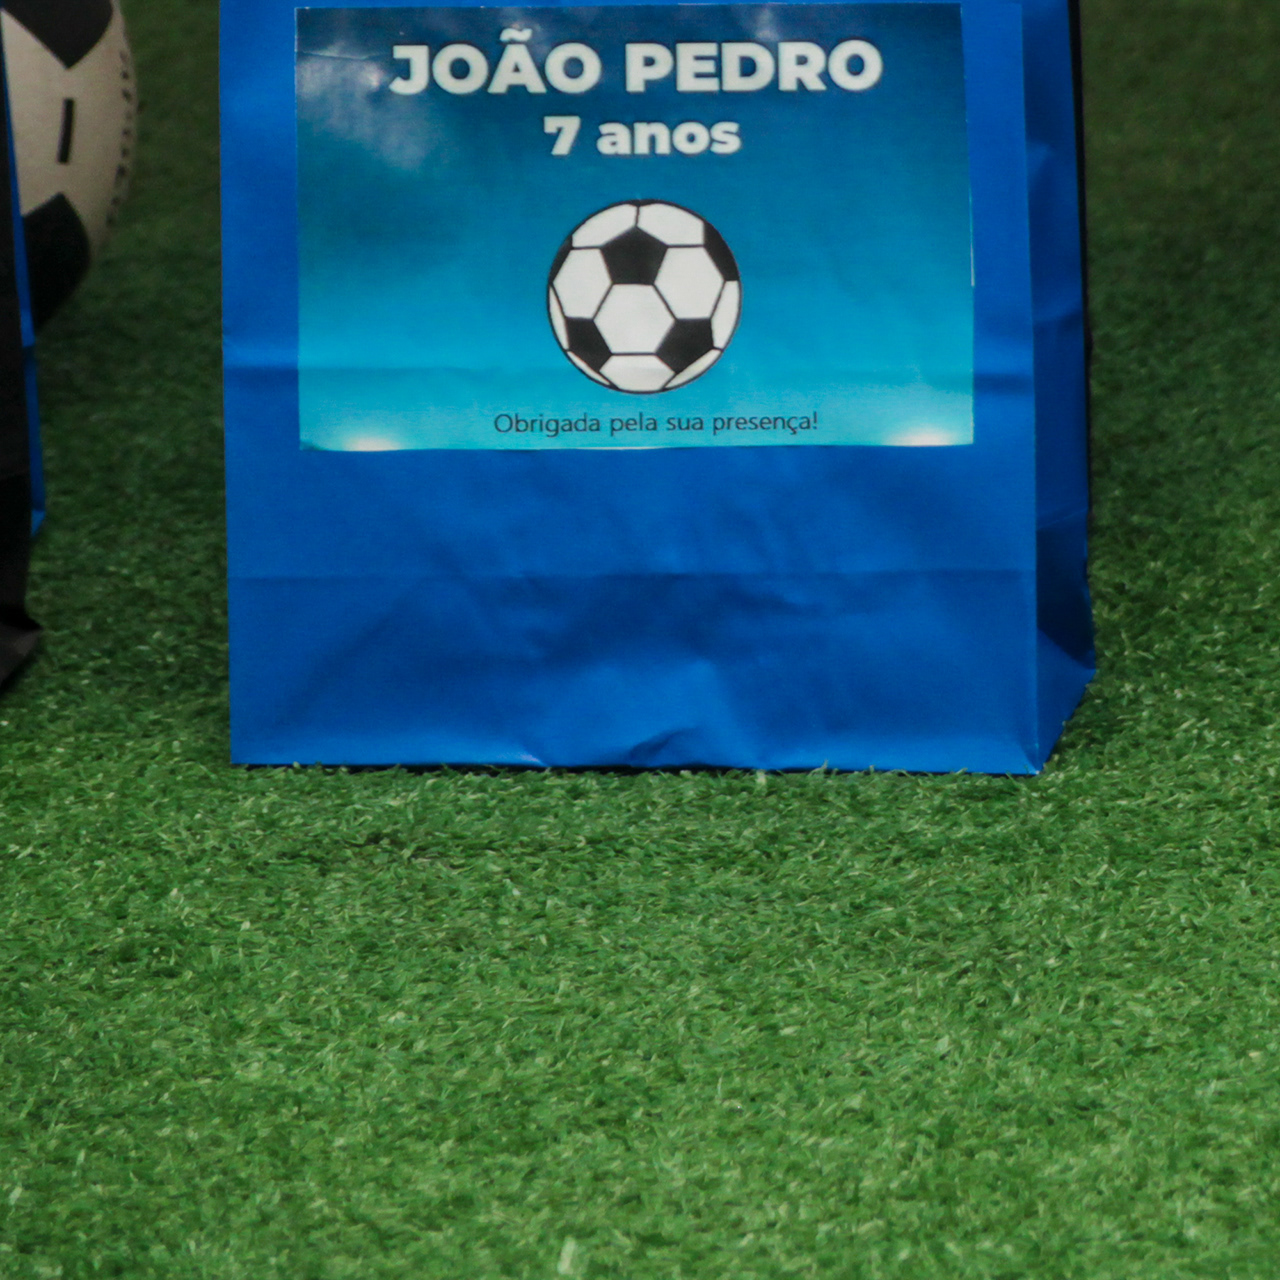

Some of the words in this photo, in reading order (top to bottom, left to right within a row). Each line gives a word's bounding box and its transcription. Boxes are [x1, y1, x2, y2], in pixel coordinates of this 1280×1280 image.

[389, 28, 601, 95] JOÃO
[625, 39, 884, 93] PEDRO
[544, 115, 580, 155] 7
[596, 120, 742, 155] anos
[494, 413, 600, 437] Obrigada
[610, 412, 658, 436] pela
[667, 415, 704, 431] sua
[713, 411, 818, 435] presença!
